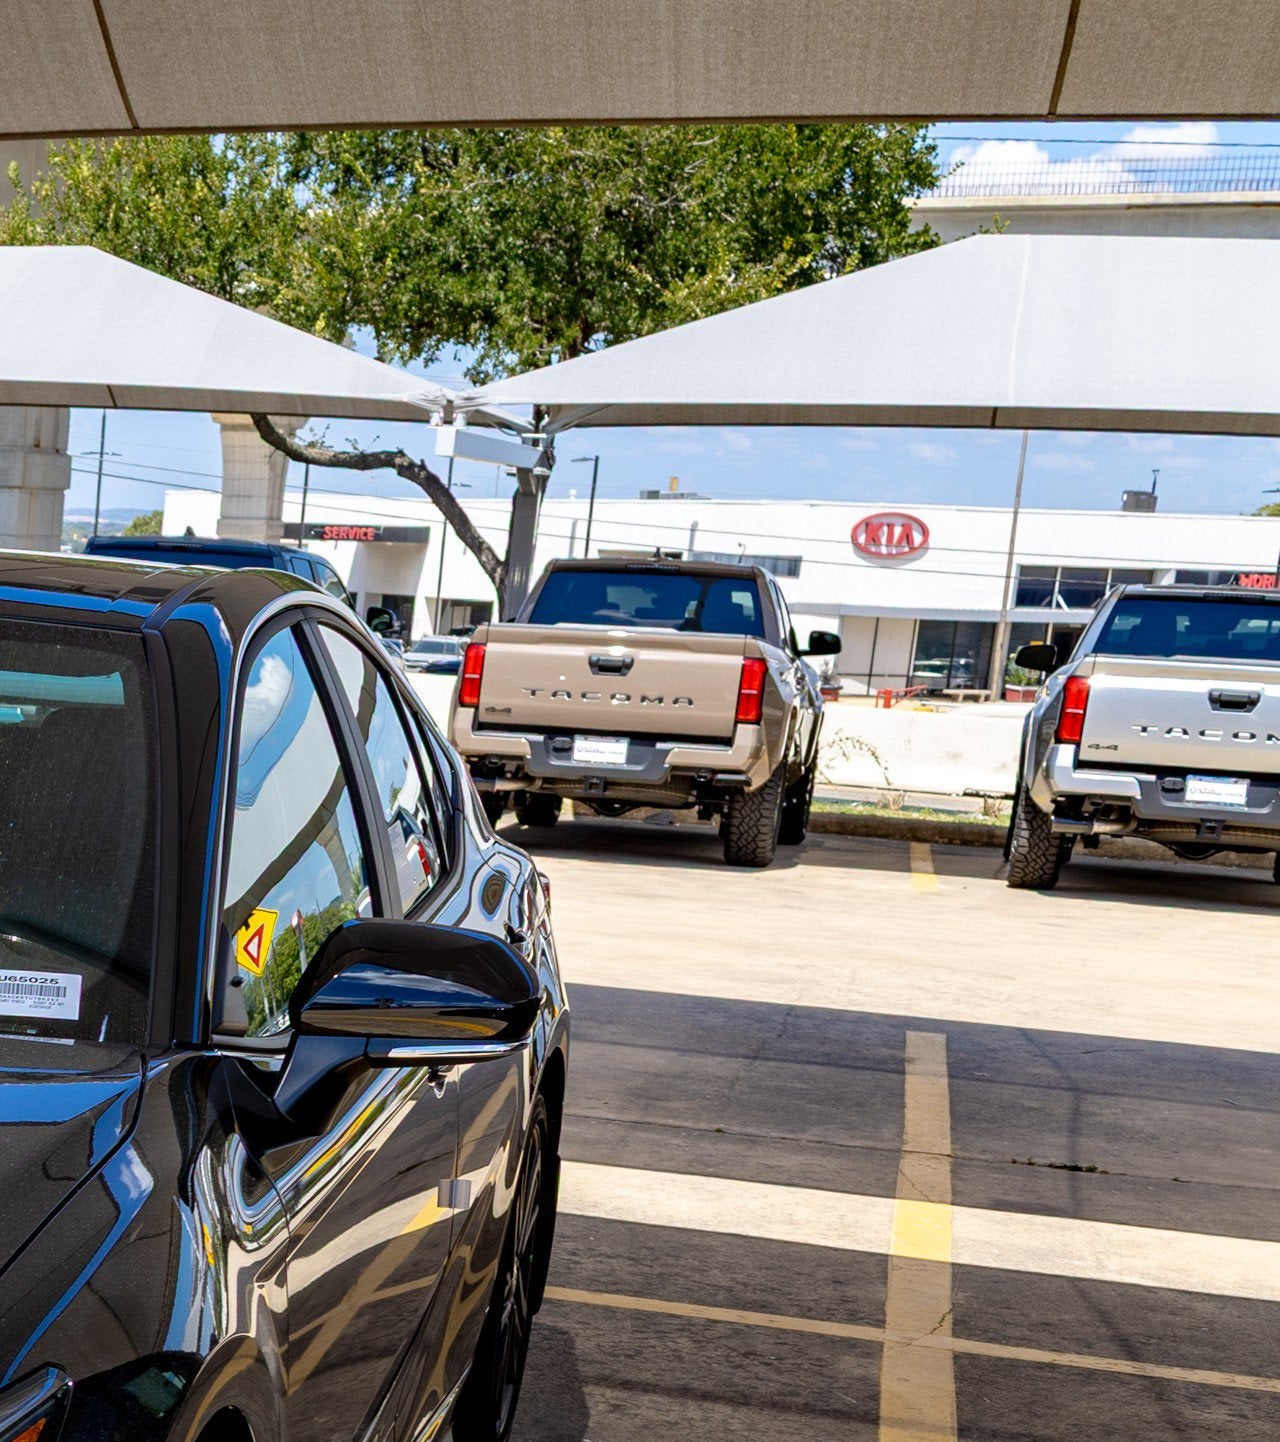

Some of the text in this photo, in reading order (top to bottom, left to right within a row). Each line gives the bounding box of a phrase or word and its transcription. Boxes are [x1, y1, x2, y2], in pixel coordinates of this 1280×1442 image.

[323, 525, 376, 541] SERVICE
[864, 521, 915, 547] KIA
[521, 686, 695, 708] TACOMA
